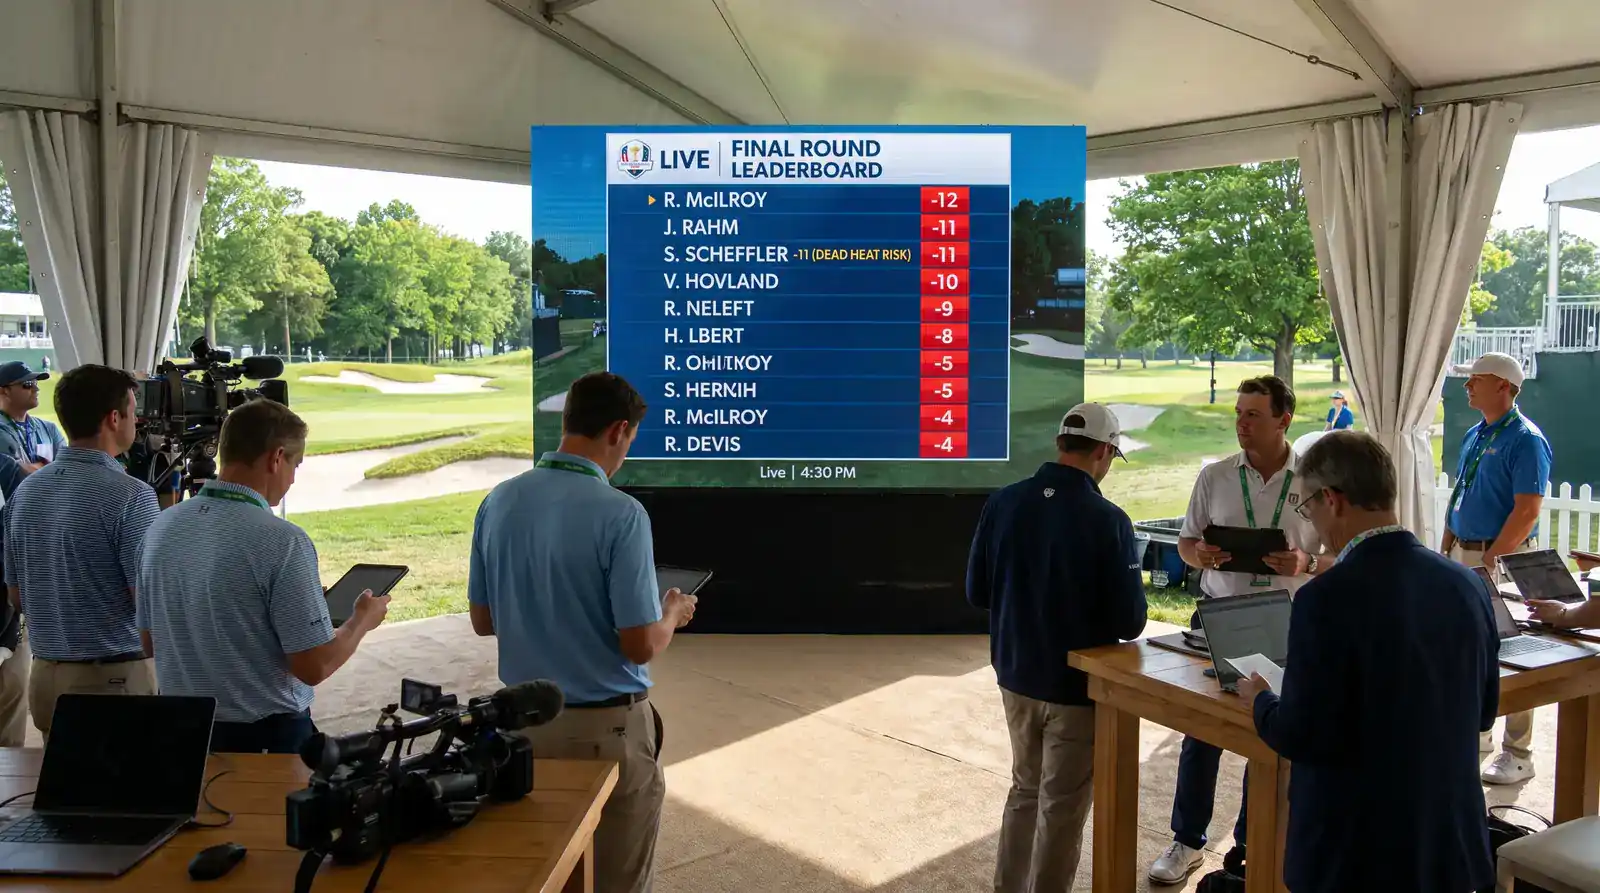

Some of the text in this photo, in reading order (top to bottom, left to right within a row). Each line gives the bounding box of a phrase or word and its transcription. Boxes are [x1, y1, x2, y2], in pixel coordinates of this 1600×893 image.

[731, 139, 881, 158] FINAL ROUND
[660, 149, 710, 170] LIVE
[731, 161, 883, 179] LEADERBOARD
[664, 191, 958, 208] R. McILROY -12
[663, 218, 956, 236] J. RAHM -11
[663, 245, 956, 263] S. SCHEFFLER -11 (DEAD HEAT RISK) -11
[663, 273, 959, 290] V. HOVLAND -10
[664, 300, 954, 317] R. NELEFT -9
[664, 327, 953, 344] H. LBERT -8
[664, 354, 681, 371] R.
[934, 355, 953, 371] -5
[664, 382, 681, 398] S.
[934, 382, 953, 399] -5
[664, 408, 954, 426] R. McILROY -4
[665, 436, 954, 453] R. DEVIS -4
[760, 466, 786, 479] Live
[800, 466, 832, 479] 4:30
[835, 466, 856, 479] PM
